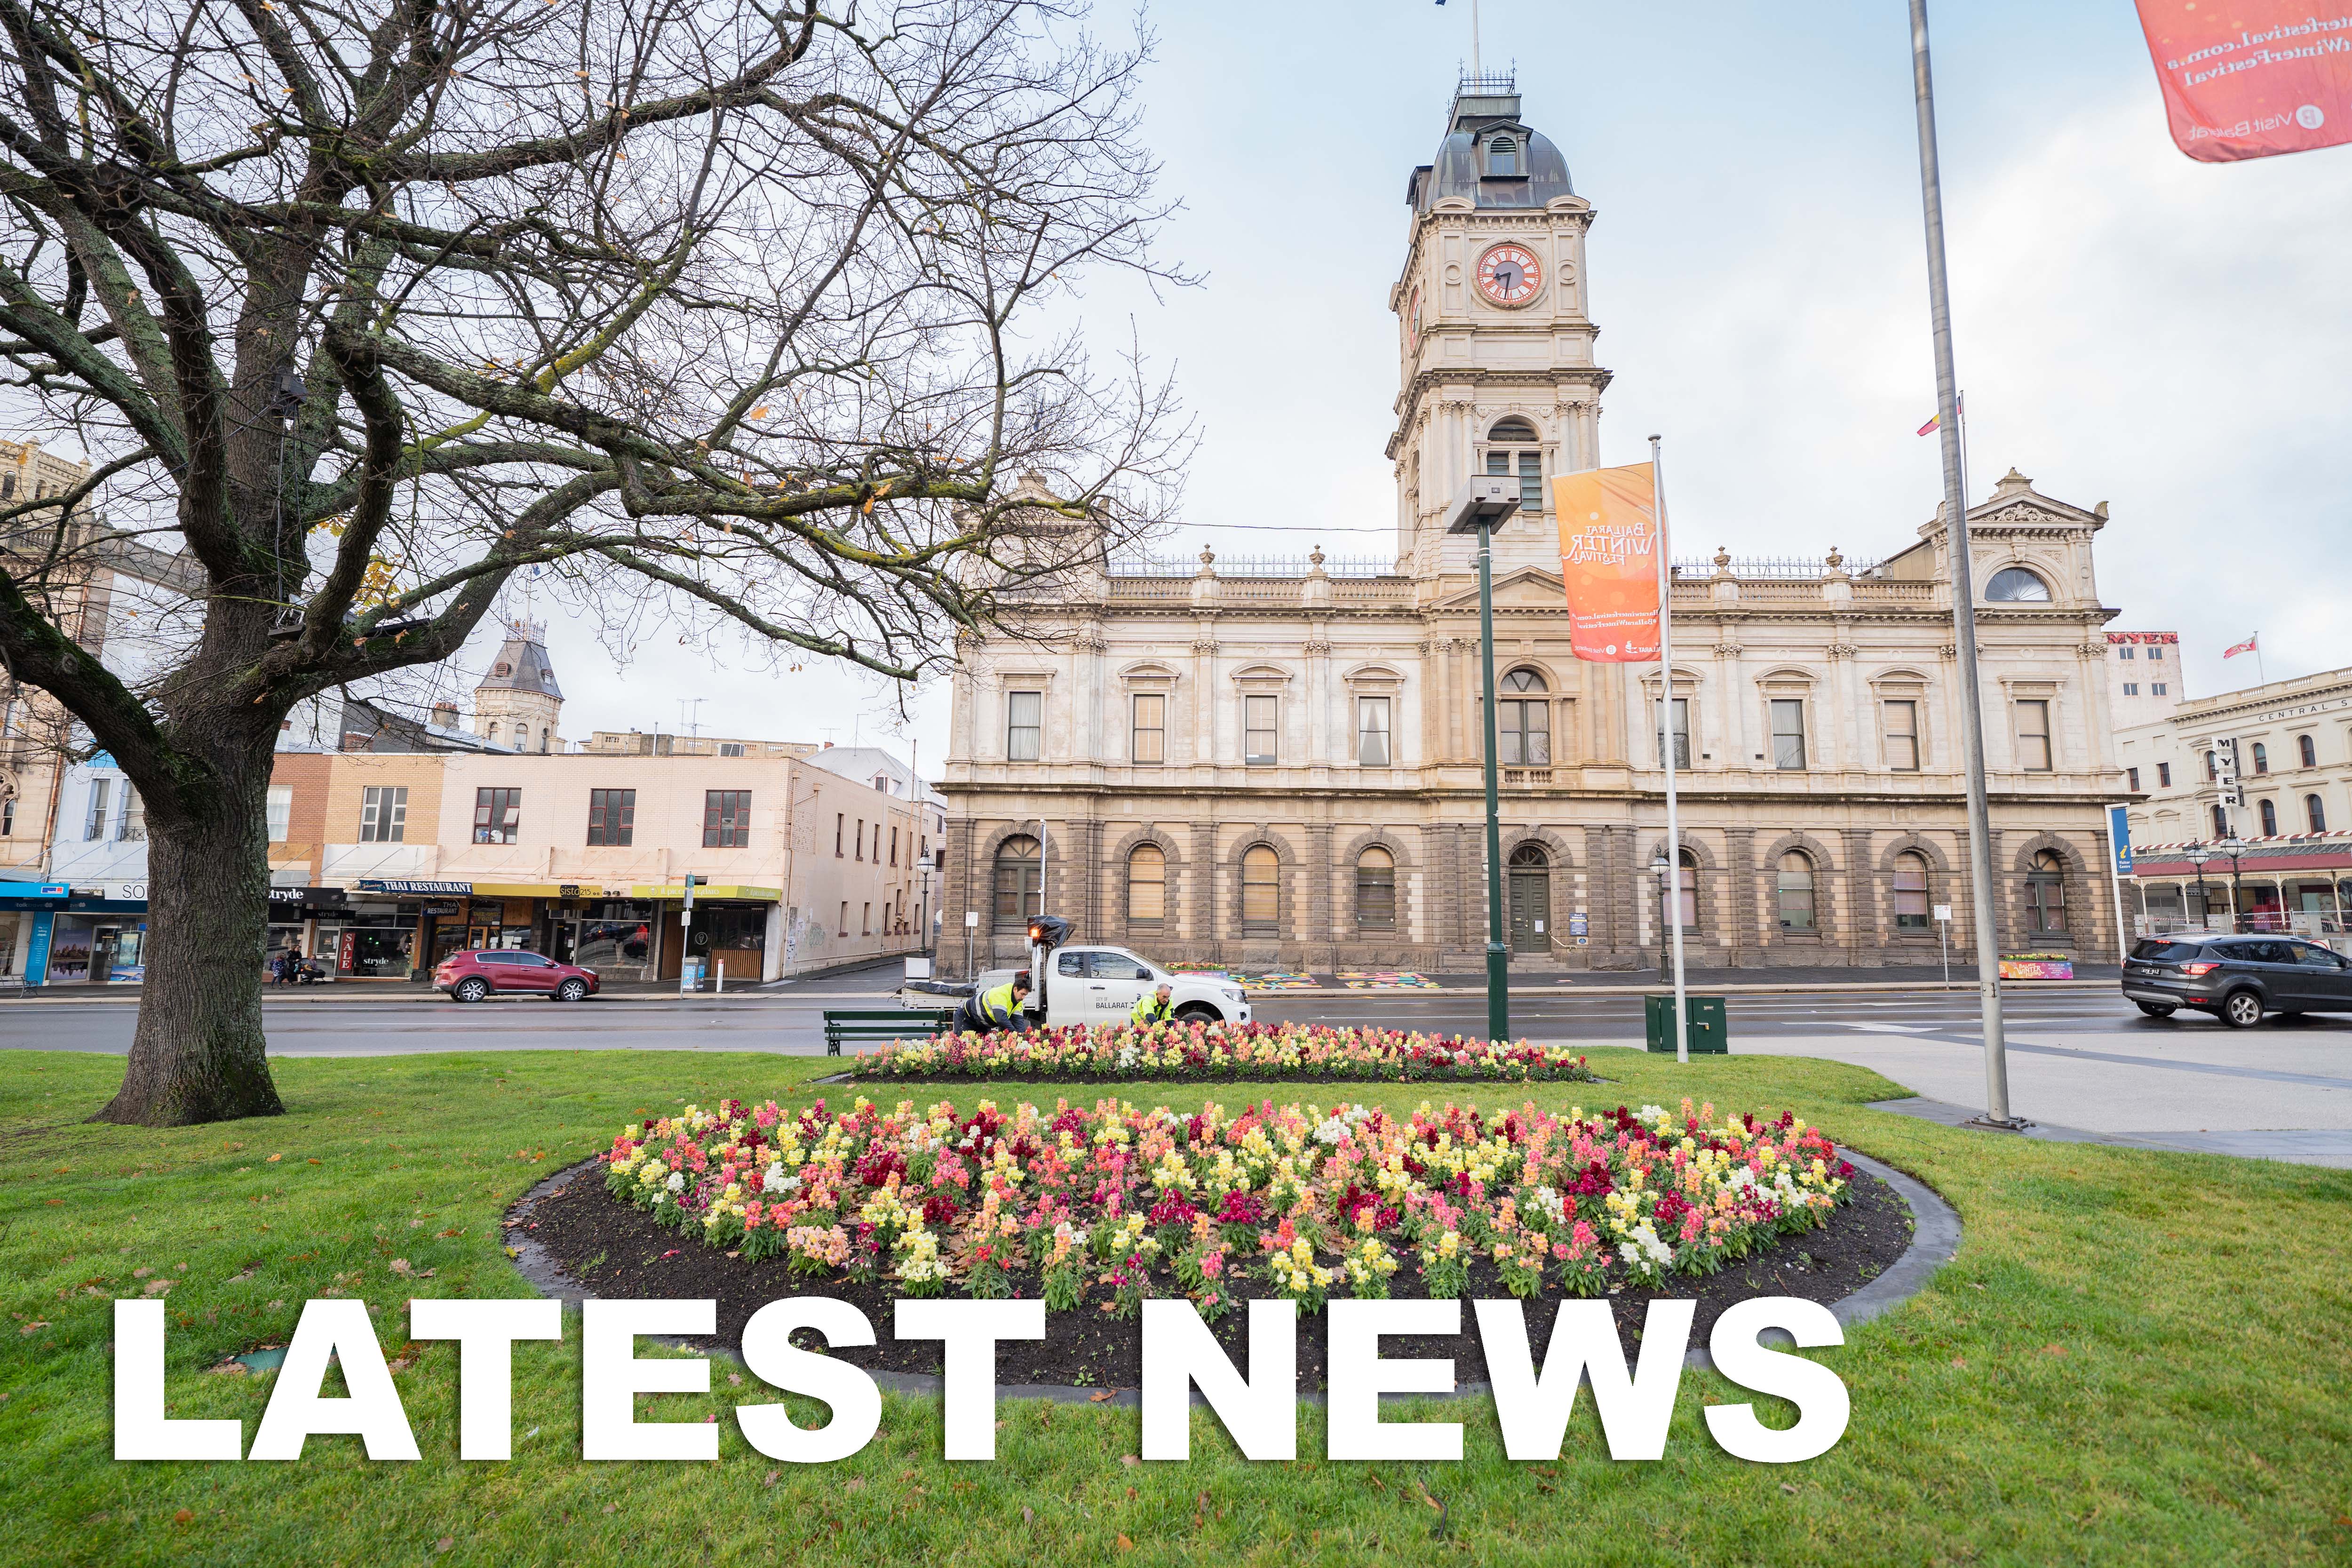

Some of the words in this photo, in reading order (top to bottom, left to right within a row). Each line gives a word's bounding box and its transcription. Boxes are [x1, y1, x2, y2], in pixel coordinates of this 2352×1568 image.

[2106, 634, 2179, 644] MYER
[2259, 703, 2328, 722] CENTRAL
[2217, 740, 2236, 804] MYER
[122, 884, 149, 899] SO
[383, 881, 409, 891] THAI
[409, 882, 471, 893] RESTAURANT
[342, 933, 353, 969] SALE
[363, 957, 389, 966] stryde
[2014, 966, 2045, 975] WINTER
